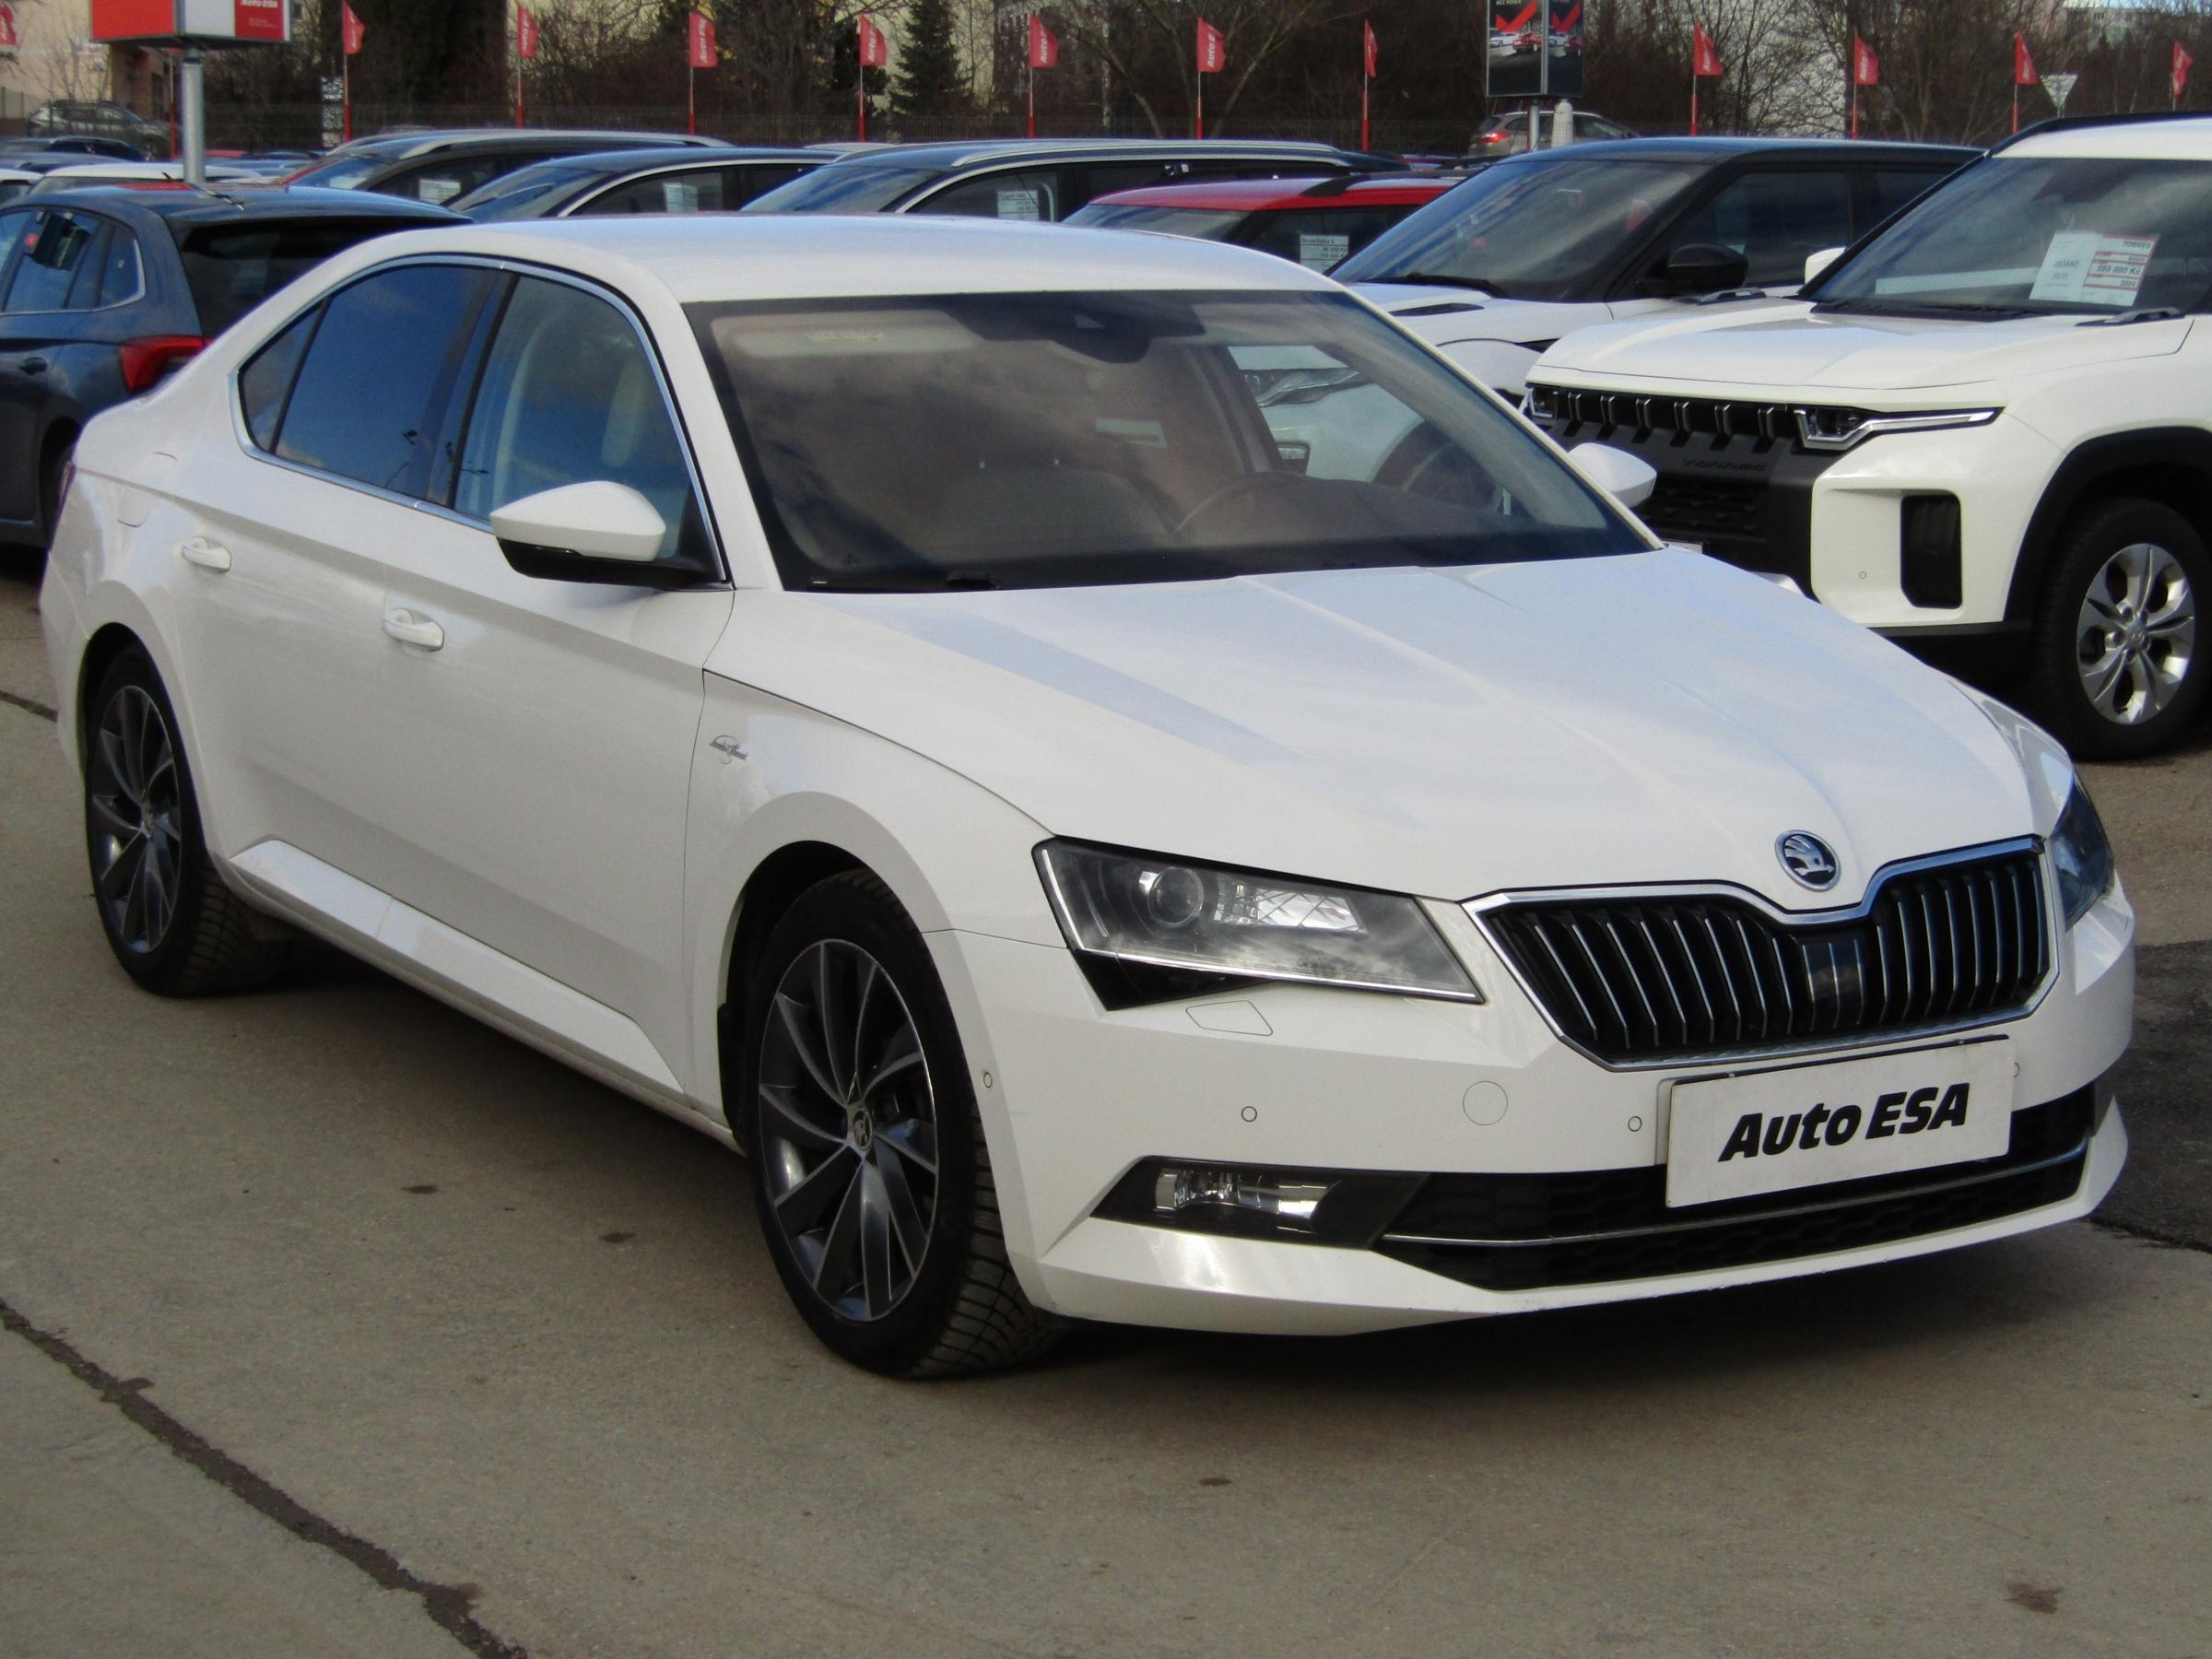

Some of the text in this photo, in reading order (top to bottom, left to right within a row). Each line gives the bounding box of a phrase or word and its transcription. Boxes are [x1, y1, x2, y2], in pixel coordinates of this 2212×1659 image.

[1207, 42, 1216, 68] Auto
[1717, 1082, 1971, 1162] Auto ESA
